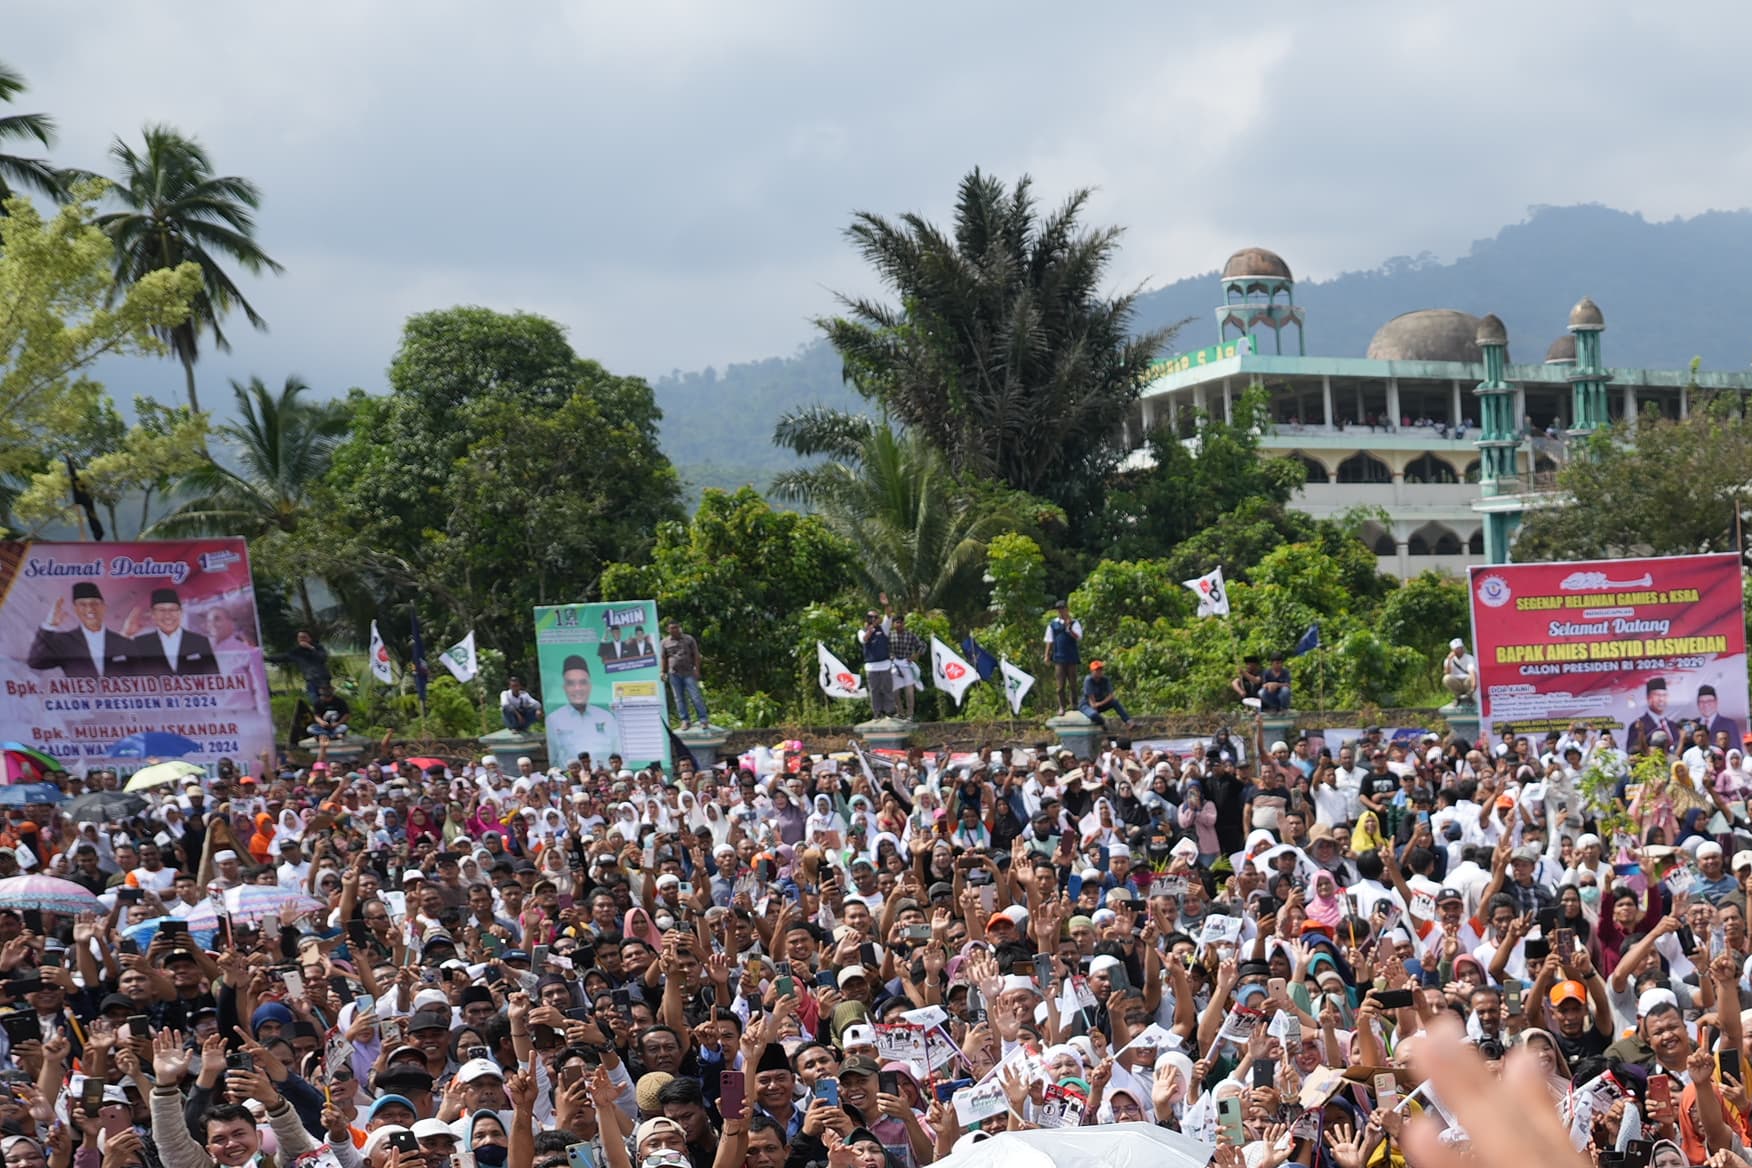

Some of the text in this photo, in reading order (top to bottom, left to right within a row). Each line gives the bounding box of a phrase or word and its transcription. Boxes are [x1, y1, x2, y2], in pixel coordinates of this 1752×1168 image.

[25, 557, 104, 577] Selamat
[110, 556, 188, 584] Datang
[1516, 596, 1563, 610] SEGENAP
[1549, 618, 1669, 637] Selamat Datang
[1496, 636, 1727, 663] BAPAK ANIES RASYID BASWEDAN
[1520, 664, 1560, 675] CALON
[1563, 661, 1619, 673] PRESIDEN
[1622, 660, 1634, 671] RI
[1636, 659, 1665, 670] 2024
[6, 674, 247, 698] Bpk. ANIES RASYID BASWEDAN
[45, 696, 218, 711] CALON PRESIDEN RI 2024
[32, 727, 68, 740] Bpk.
[208, 741, 239, 754] 2024
